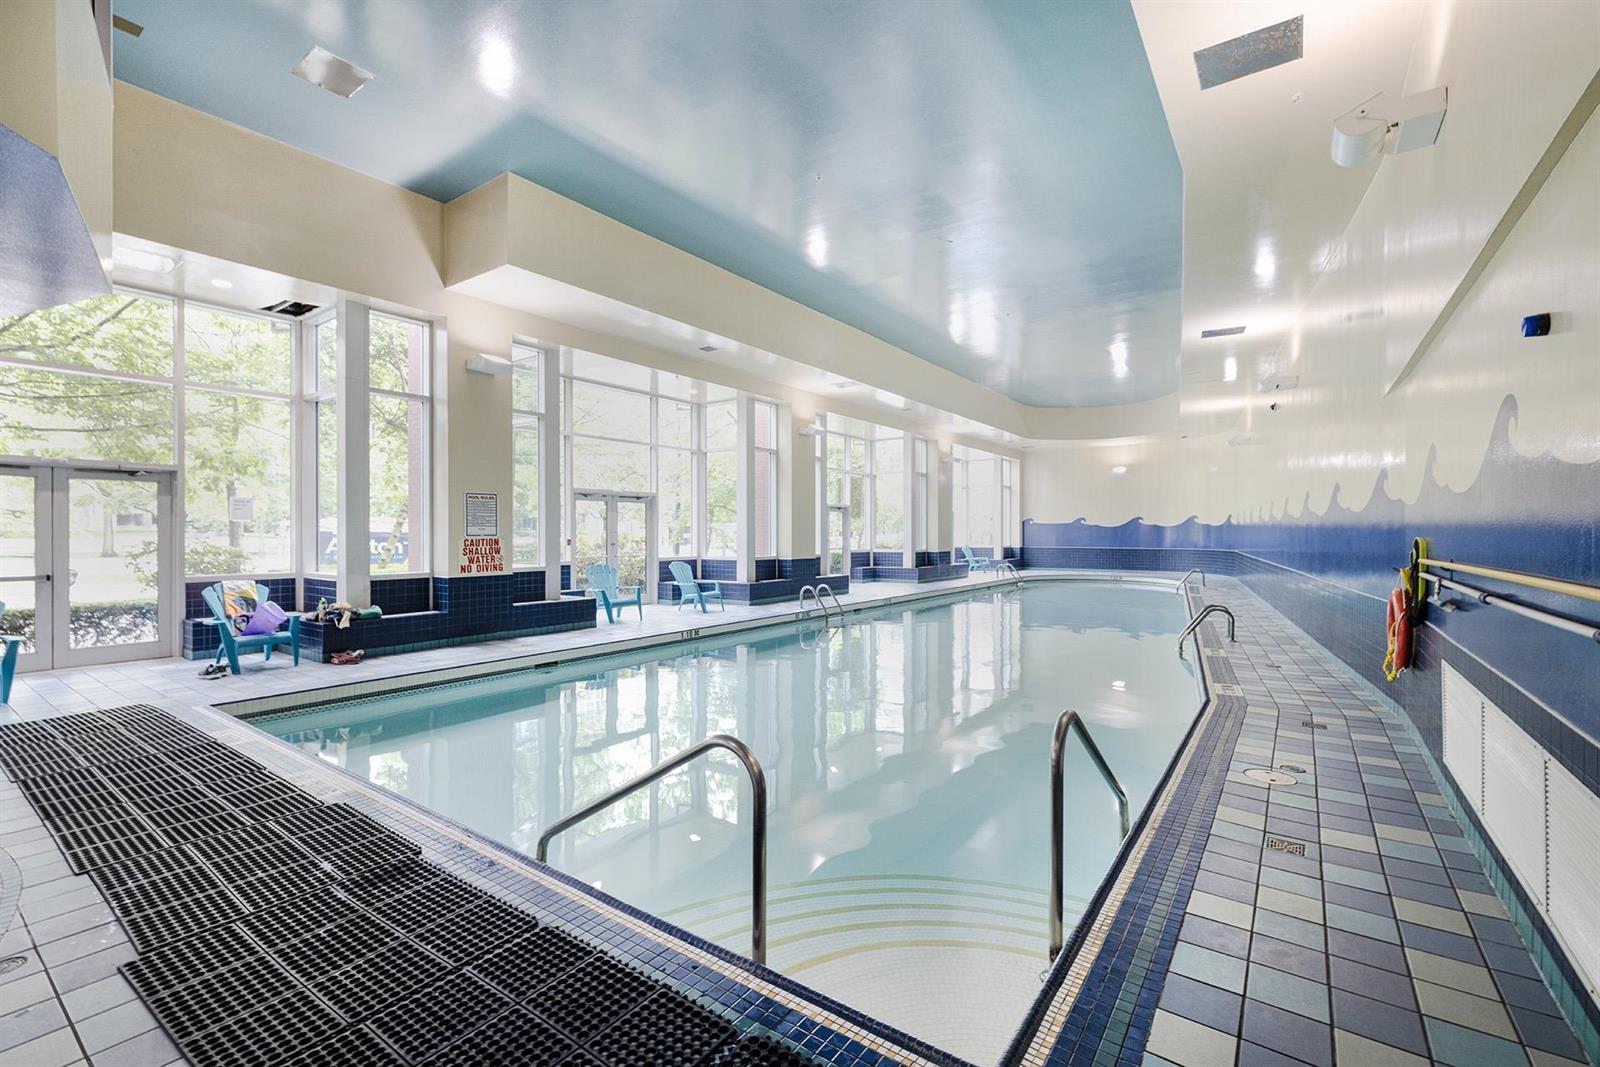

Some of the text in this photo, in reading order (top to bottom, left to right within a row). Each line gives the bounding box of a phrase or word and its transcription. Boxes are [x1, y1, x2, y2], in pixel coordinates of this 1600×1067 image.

[463, 538, 500, 547] CAUTION
[462, 547, 501, 556] SHALLOW
[467, 555, 496, 564] WATER
[460, 563, 504, 573] NO DIVING
